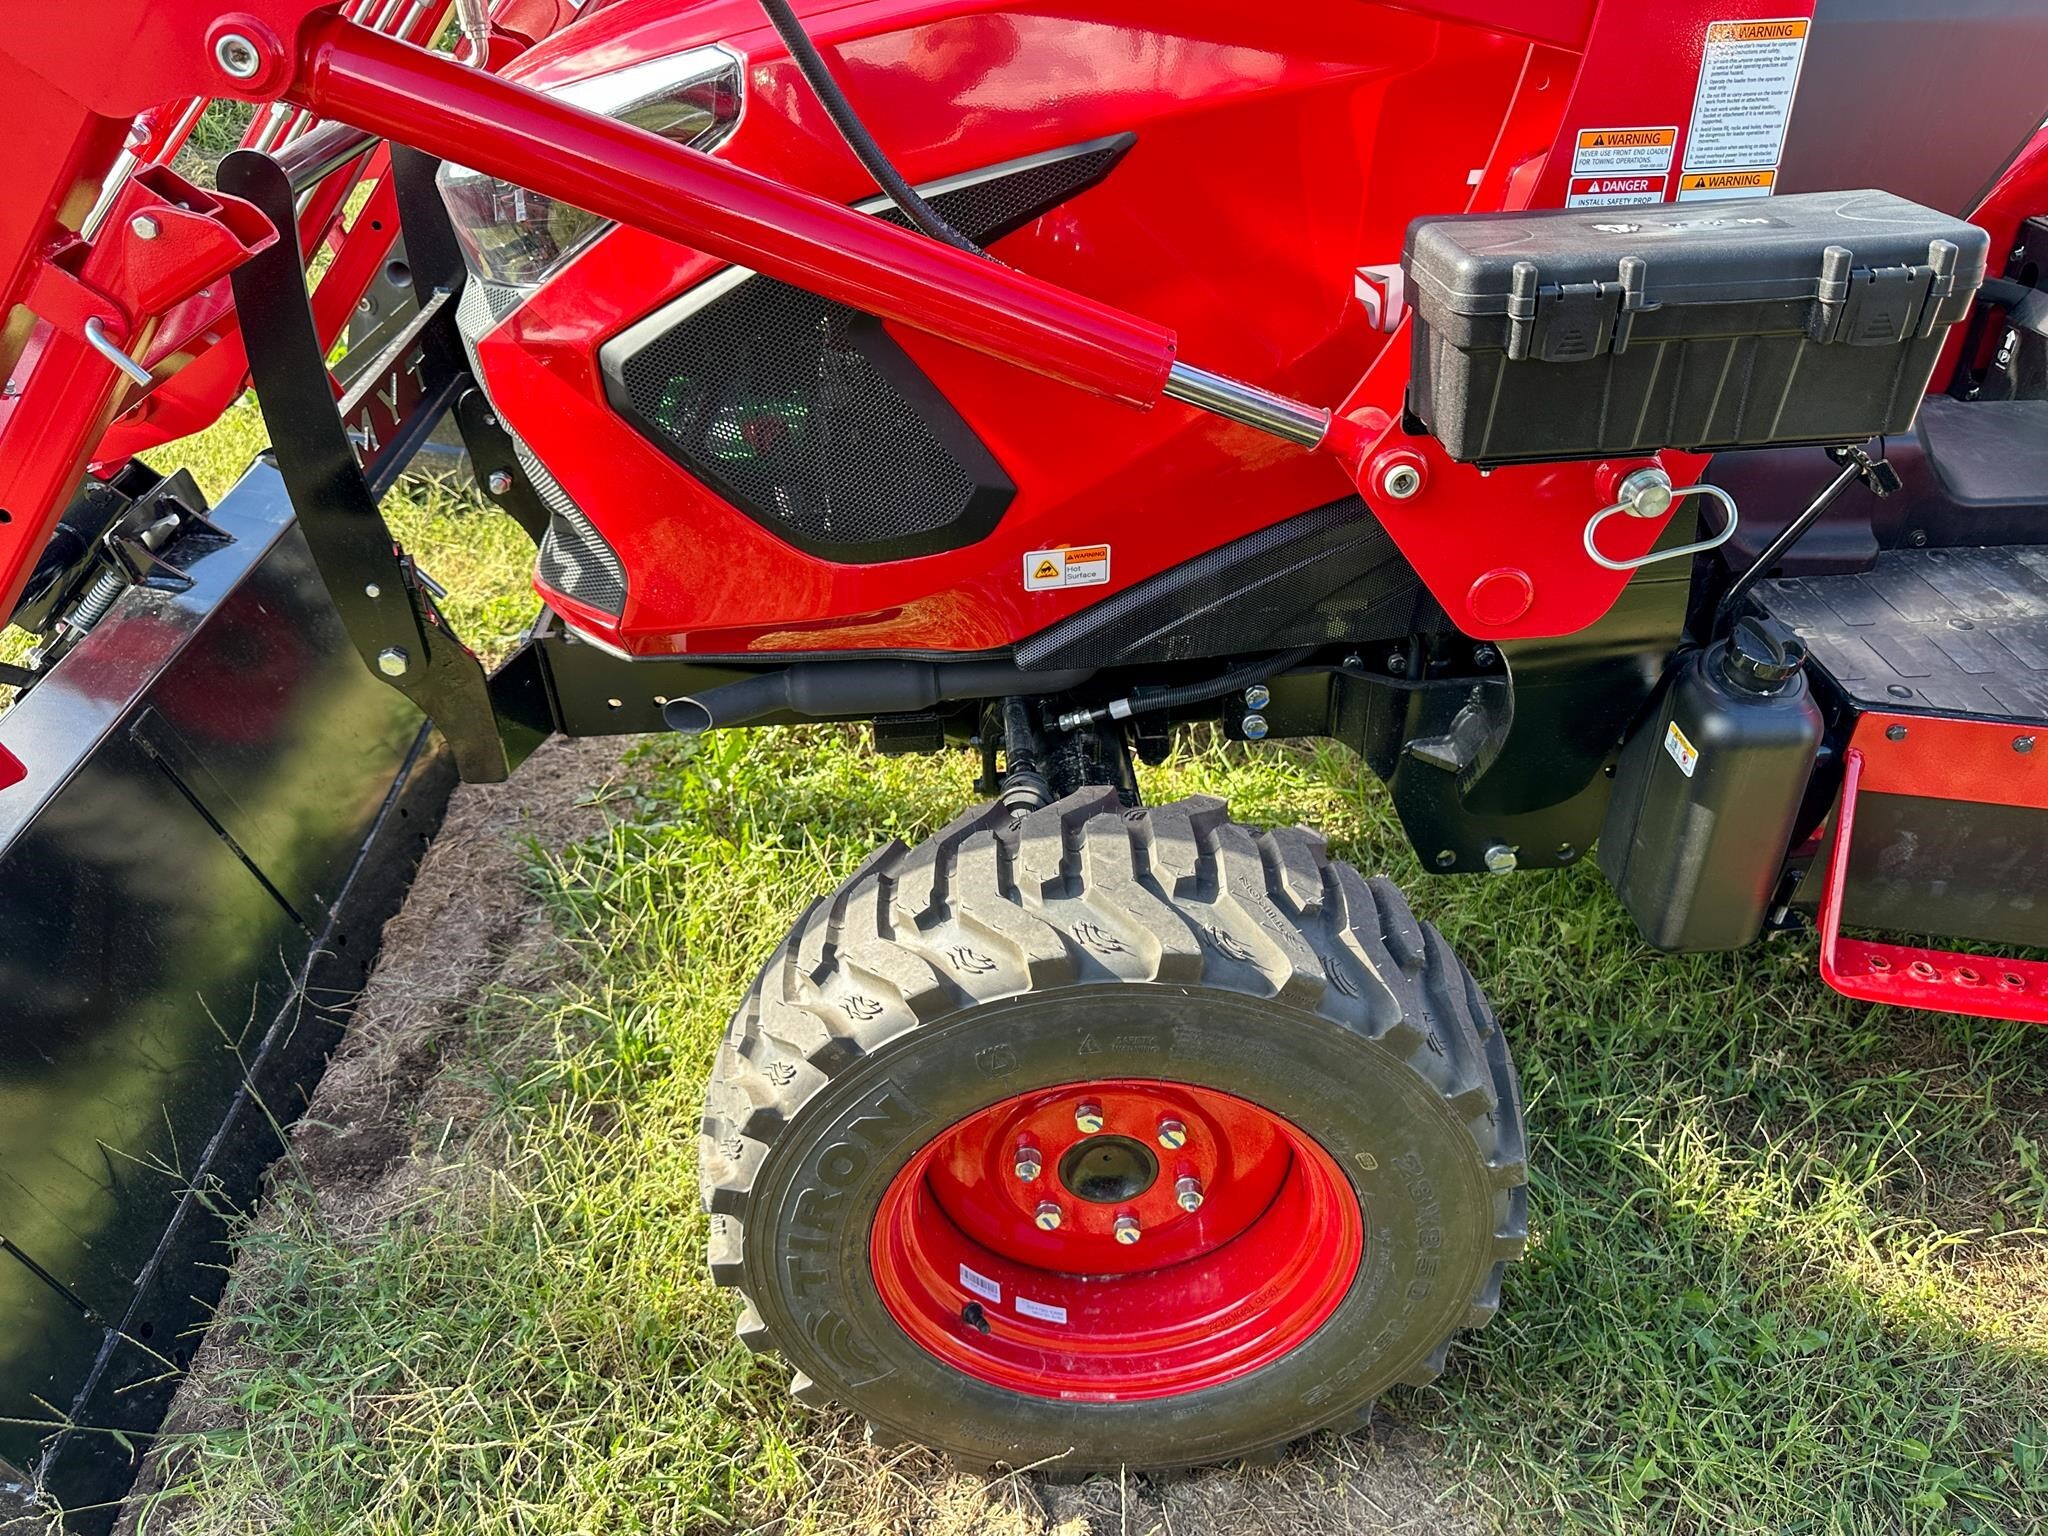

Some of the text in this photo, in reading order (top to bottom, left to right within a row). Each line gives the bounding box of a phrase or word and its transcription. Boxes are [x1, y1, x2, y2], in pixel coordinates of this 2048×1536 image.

[1740, 25, 1793, 38] WARNING
[1607, 133, 1661, 145] WARNING
[1602, 180, 1648, 192] DANGER
[1708, 175, 1760, 187] WARNING
[1578, 196, 1652, 206] INSTALL SAFETY PROP
[1074, 551, 1105, 560] WARNING
[1067, 572, 1097, 580] Surface
